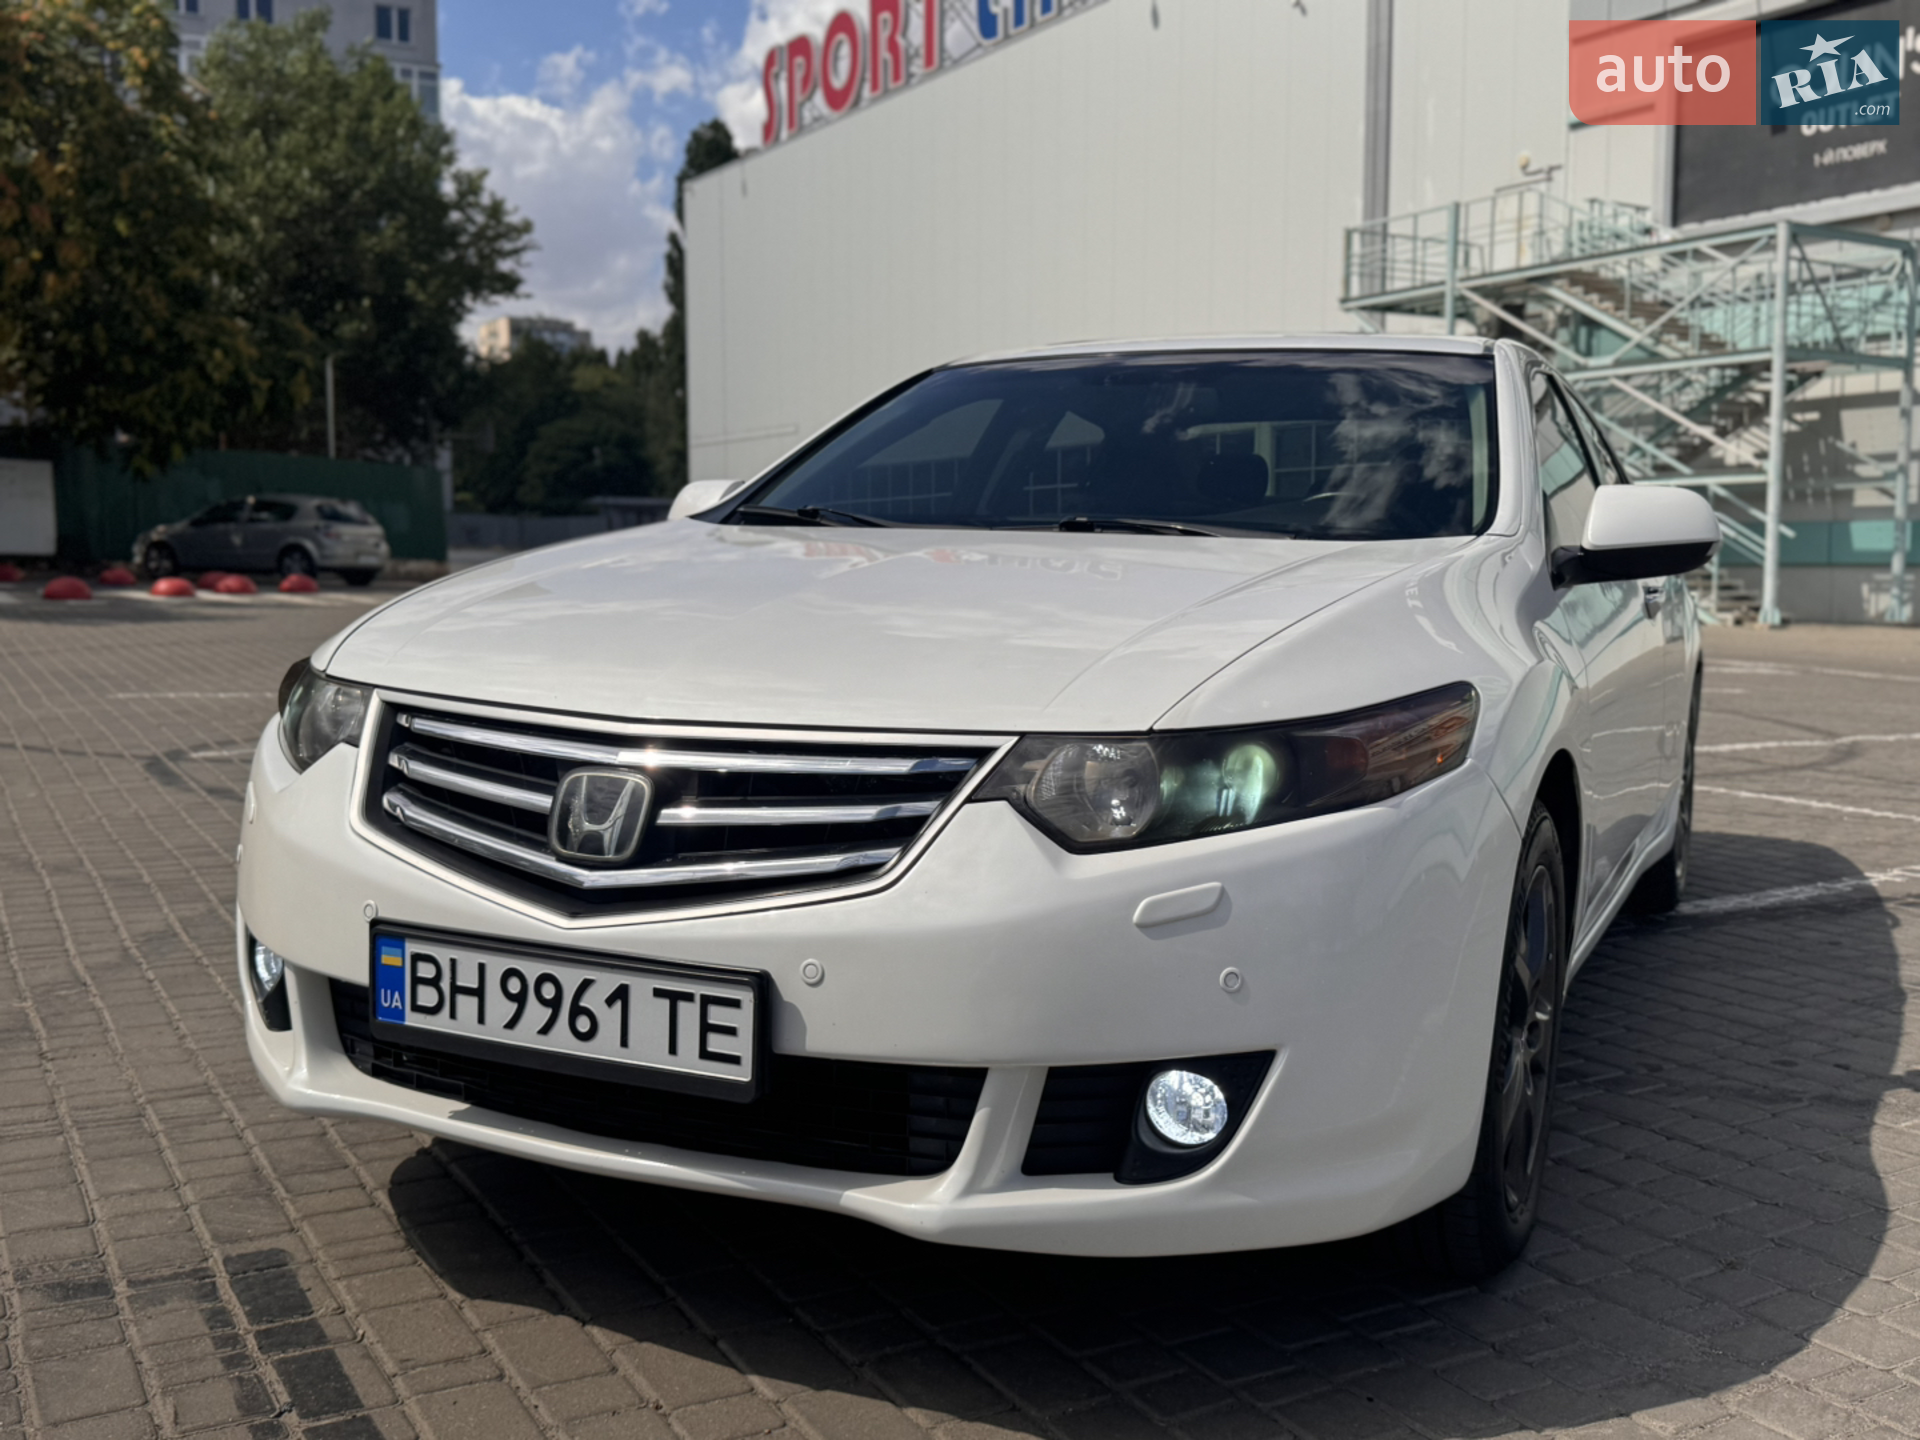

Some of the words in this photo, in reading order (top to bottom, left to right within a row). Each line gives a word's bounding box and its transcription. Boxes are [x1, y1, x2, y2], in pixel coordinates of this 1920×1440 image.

[380, 988, 403, 1010] UA
[410, 950, 486, 1026] BH
[500, 966, 631, 1048] 9961
[652, 986, 742, 1066] TE
